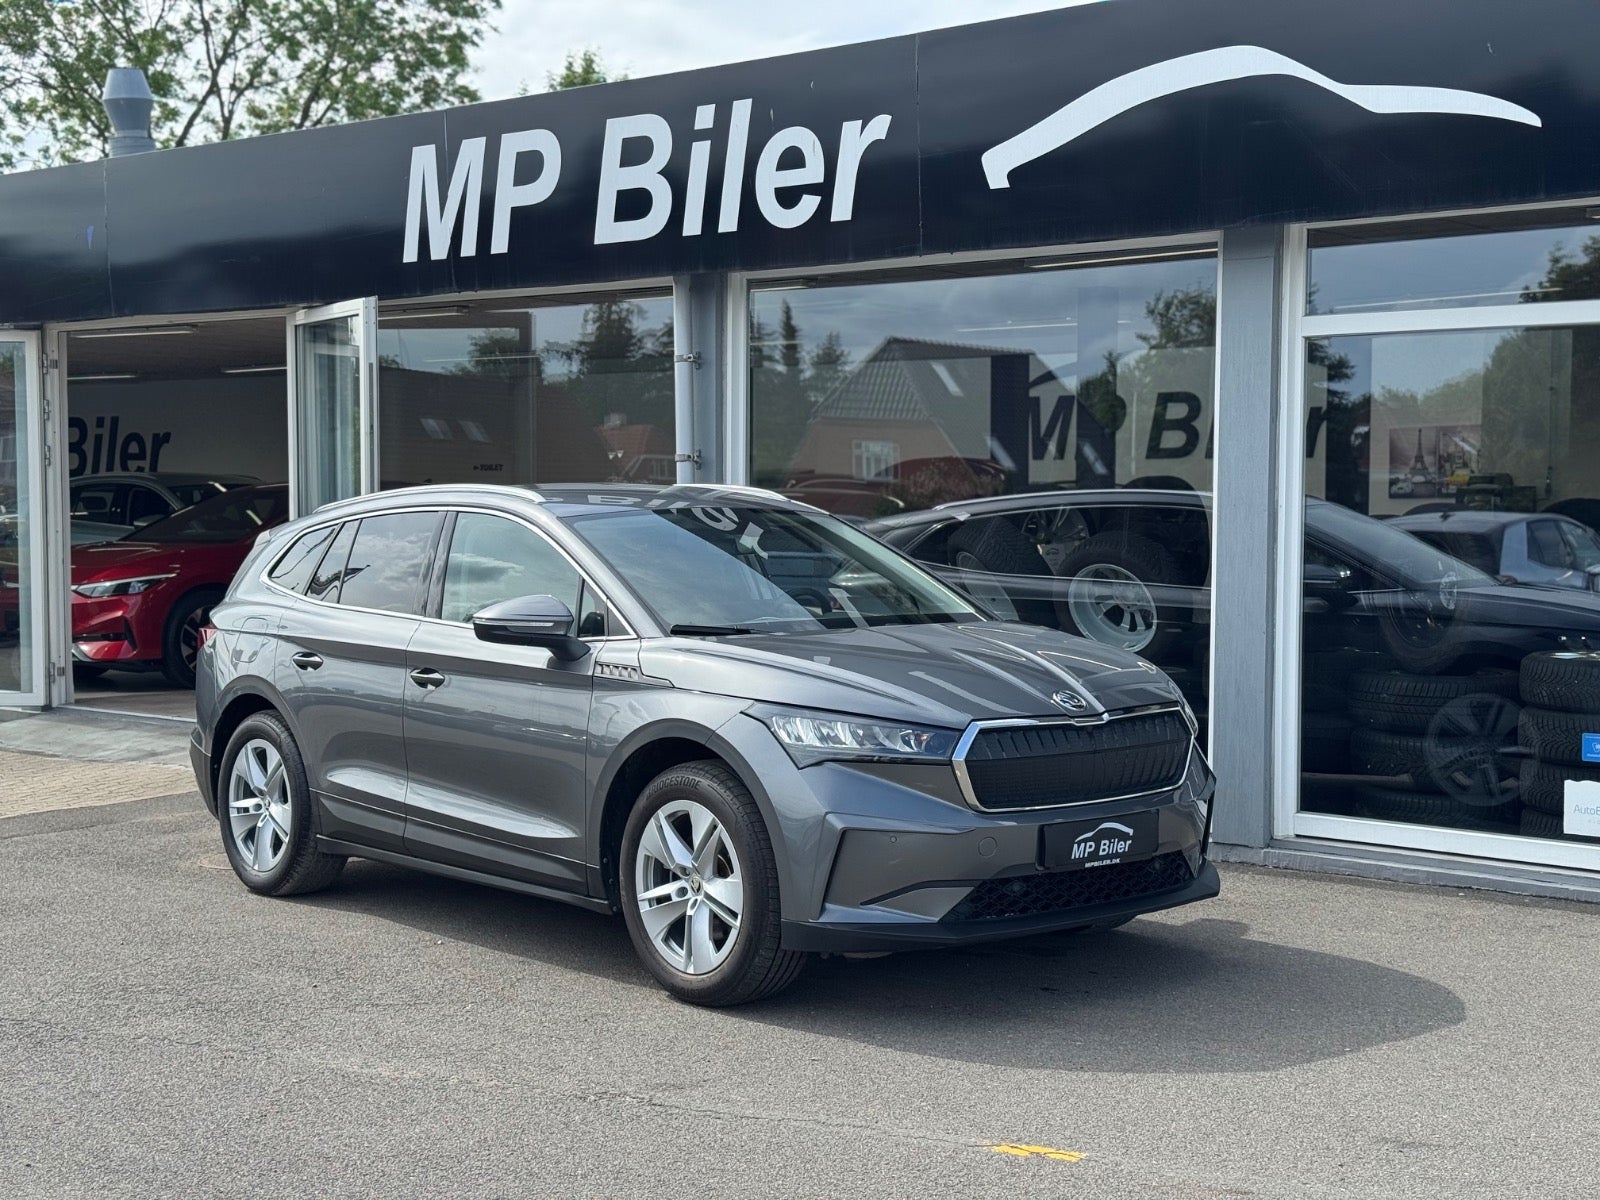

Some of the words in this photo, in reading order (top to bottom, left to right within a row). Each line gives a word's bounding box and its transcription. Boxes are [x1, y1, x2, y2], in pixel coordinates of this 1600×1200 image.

[403, 129, 562, 263] MP
[594, 98, 892, 245] Biler
[68, 416, 172, 478] Biler
[1071, 841, 1095, 859] MP
[1099, 838, 1132, 855] Biler
[1085, 858, 1120, 868] MPBILER.DK
